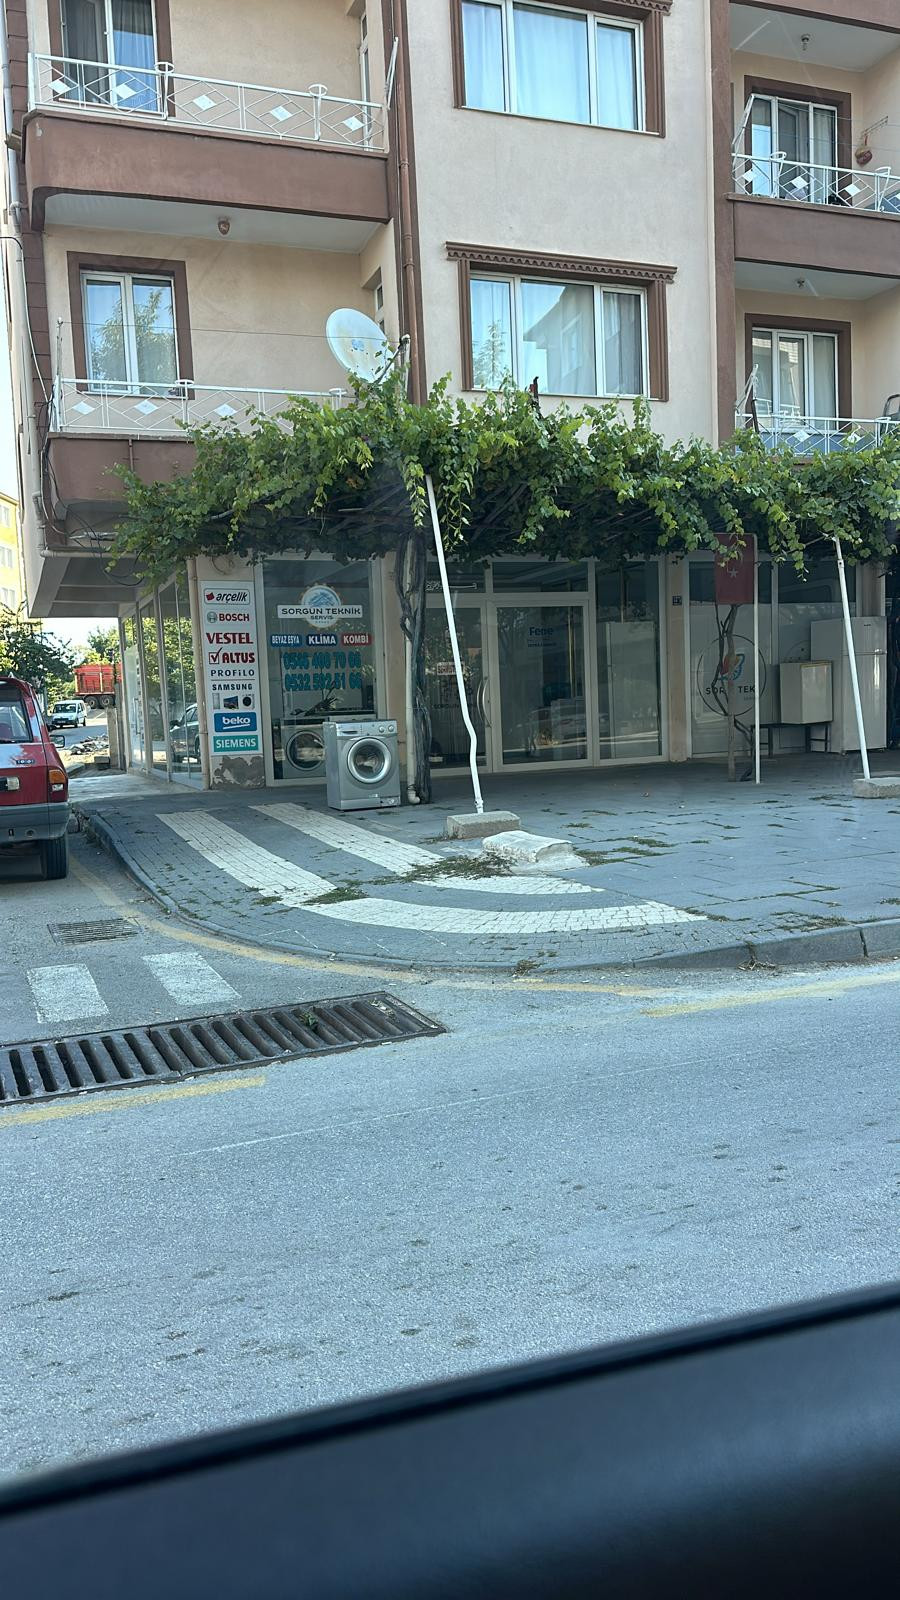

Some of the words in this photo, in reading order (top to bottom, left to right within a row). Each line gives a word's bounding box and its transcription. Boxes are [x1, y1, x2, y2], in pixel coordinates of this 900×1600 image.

[216, 592, 248, 603] arçelik
[326, 607, 361, 615] TEKNİK
[218, 613, 250, 622] BOSCH
[206, 632, 254, 644] VESTEL
[272, 635, 287, 644] BEYAZ
[308, 634, 336, 645] KLİMA
[343, 633, 369, 644] KOMBİ
[222, 652, 256, 664] ALTUS
[212, 683, 253, 691] SAMSUNG
[222, 716, 251, 725] beko
[216, 738, 256, 749] SIEMENS
